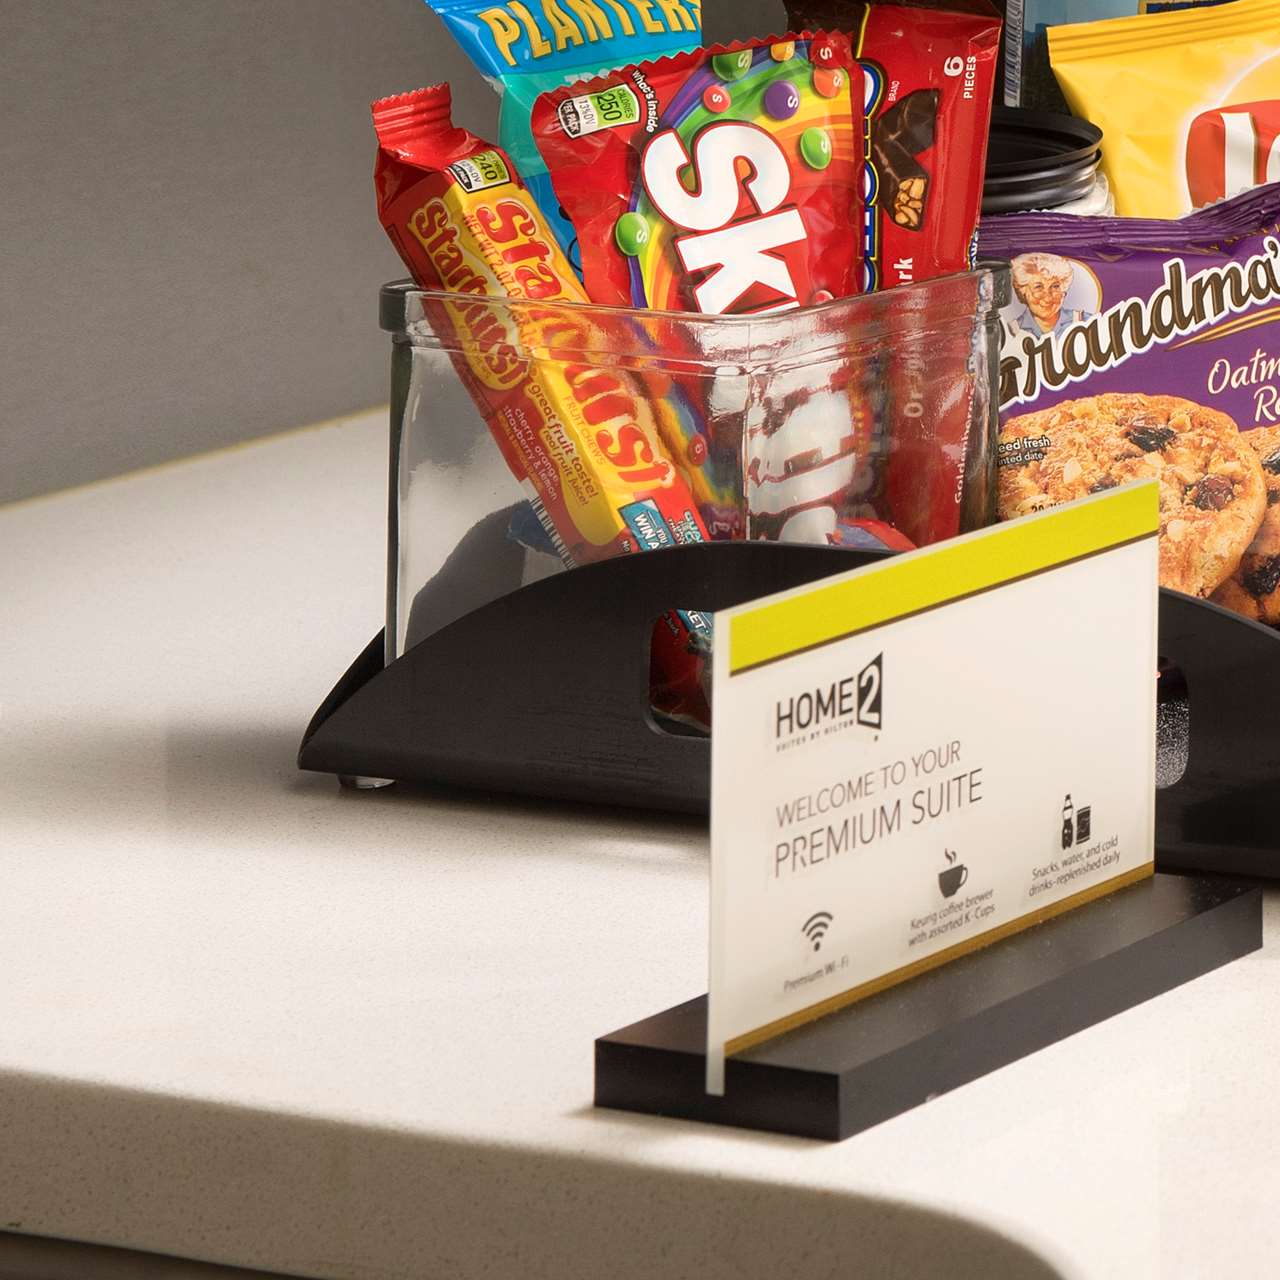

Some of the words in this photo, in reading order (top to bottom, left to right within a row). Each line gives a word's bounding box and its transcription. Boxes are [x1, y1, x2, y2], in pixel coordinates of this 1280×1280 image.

[944, 55, 964, 77] 6
[963, 55, 977, 99] PIECES
[617, 88, 634, 119] CALORIES
[632, 70, 655, 100] what's
[646, 100, 659, 133] inside
[888, 80, 901, 102] BRAND
[597, 93, 622, 121] 250
[472, 154, 498, 181] 240
[511, 406, 539, 446] cherry,
[527, 382, 558, 424] great
[549, 420, 577, 457] fruit
[568, 453, 601, 500] taste!
[562, 394, 585, 425] FRUIT
[579, 425, 608, 467] CHEWS
[501, 403, 538, 460] strawberry
[536, 468, 561, 502] lemon
[1023, 435, 1051, 449] fresh
[1024, 451, 1044, 461] date
[541, 427, 561, 452] real
[552, 449, 575, 478] fruit
[567, 475, 592, 508] juice!
[634, 512, 656, 540] WIN
[656, 527, 668, 544] YOU
[776, 772, 875, 828] WELCOME
[880, 760, 907, 789] TO
[911, 740, 961, 777] YOUR
[775, 798, 902, 878] PREMIUM
[911, 768, 983, 825] SUITE
[1085, 845, 1101, 858] and
[1101, 835, 1119, 852] cold
[1102, 850, 1121, 867] daily
[910, 912, 937, 930] Keurig
[938, 900, 964, 920] coffee
[964, 889, 994, 909] brewer
[908, 930, 928, 947] with
[928, 916, 964, 939] assorted
[784, 969, 824, 992] Premium
